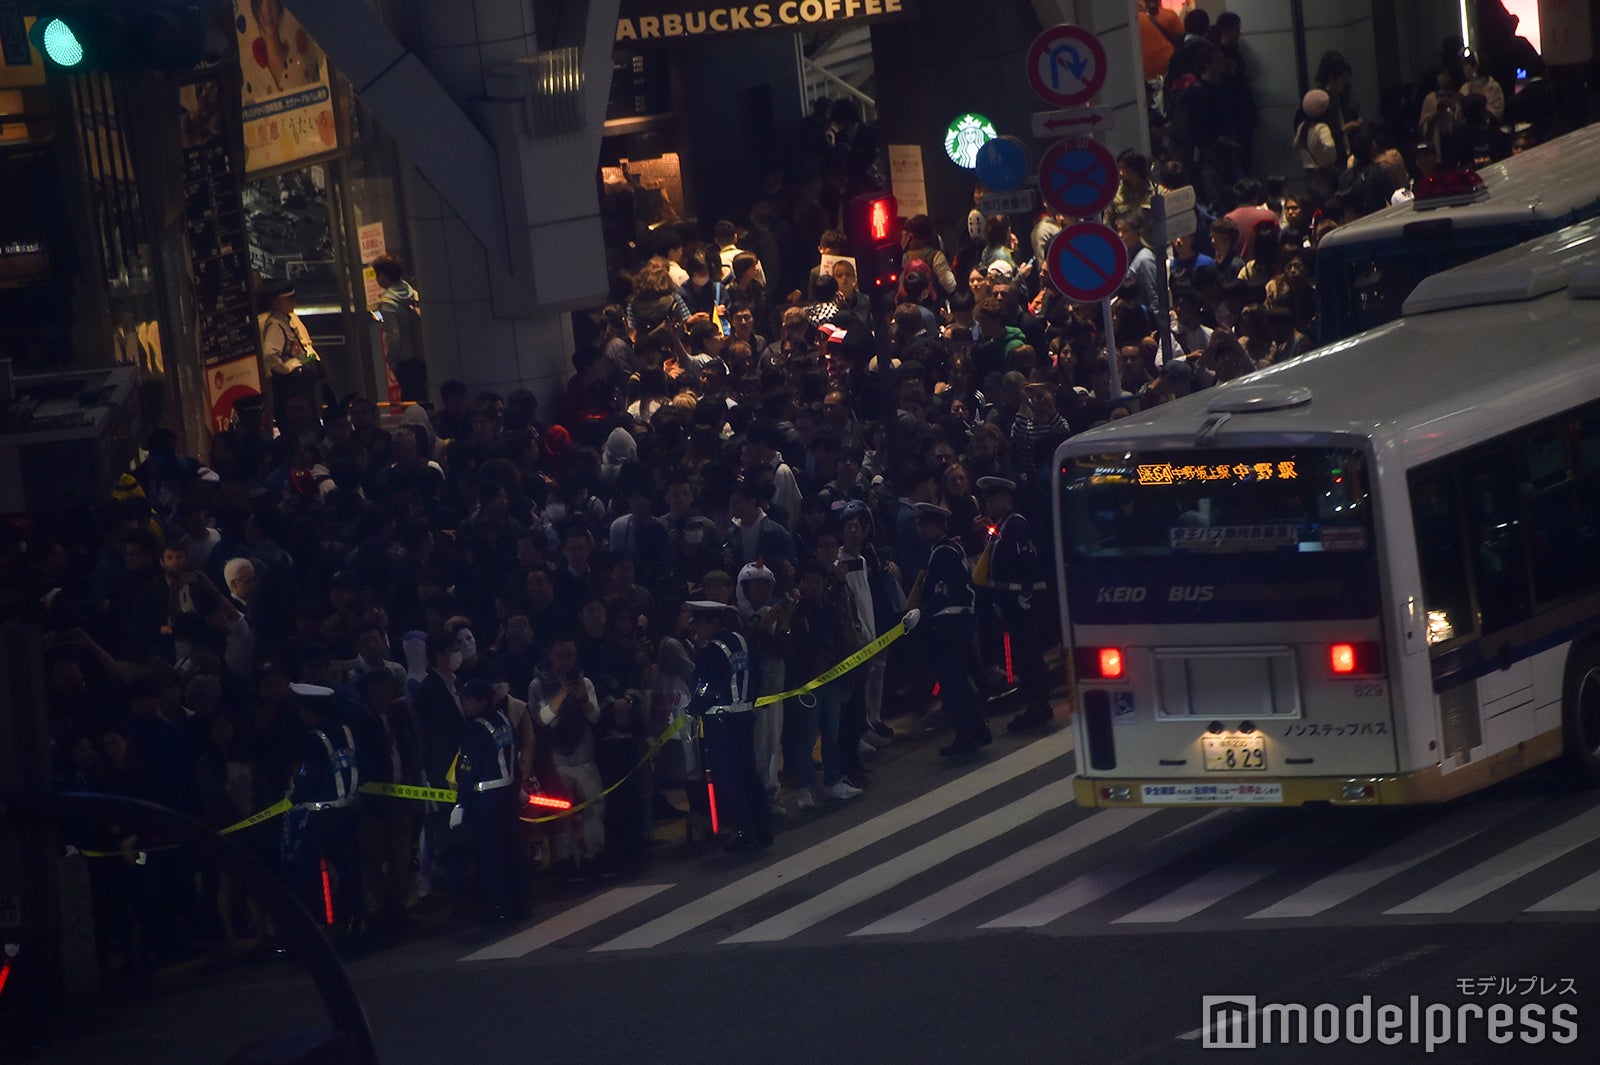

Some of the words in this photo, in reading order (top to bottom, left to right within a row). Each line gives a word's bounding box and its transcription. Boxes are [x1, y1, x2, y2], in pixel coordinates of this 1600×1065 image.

[778, 0, 903, 25] COFFEE
[1095, 585, 1148, 604] KEIO
[1167, 584, 1216, 603] BUS
[1353, 683, 1384, 698] 829
[1283, 722, 1388, 737] ノンステップバス
